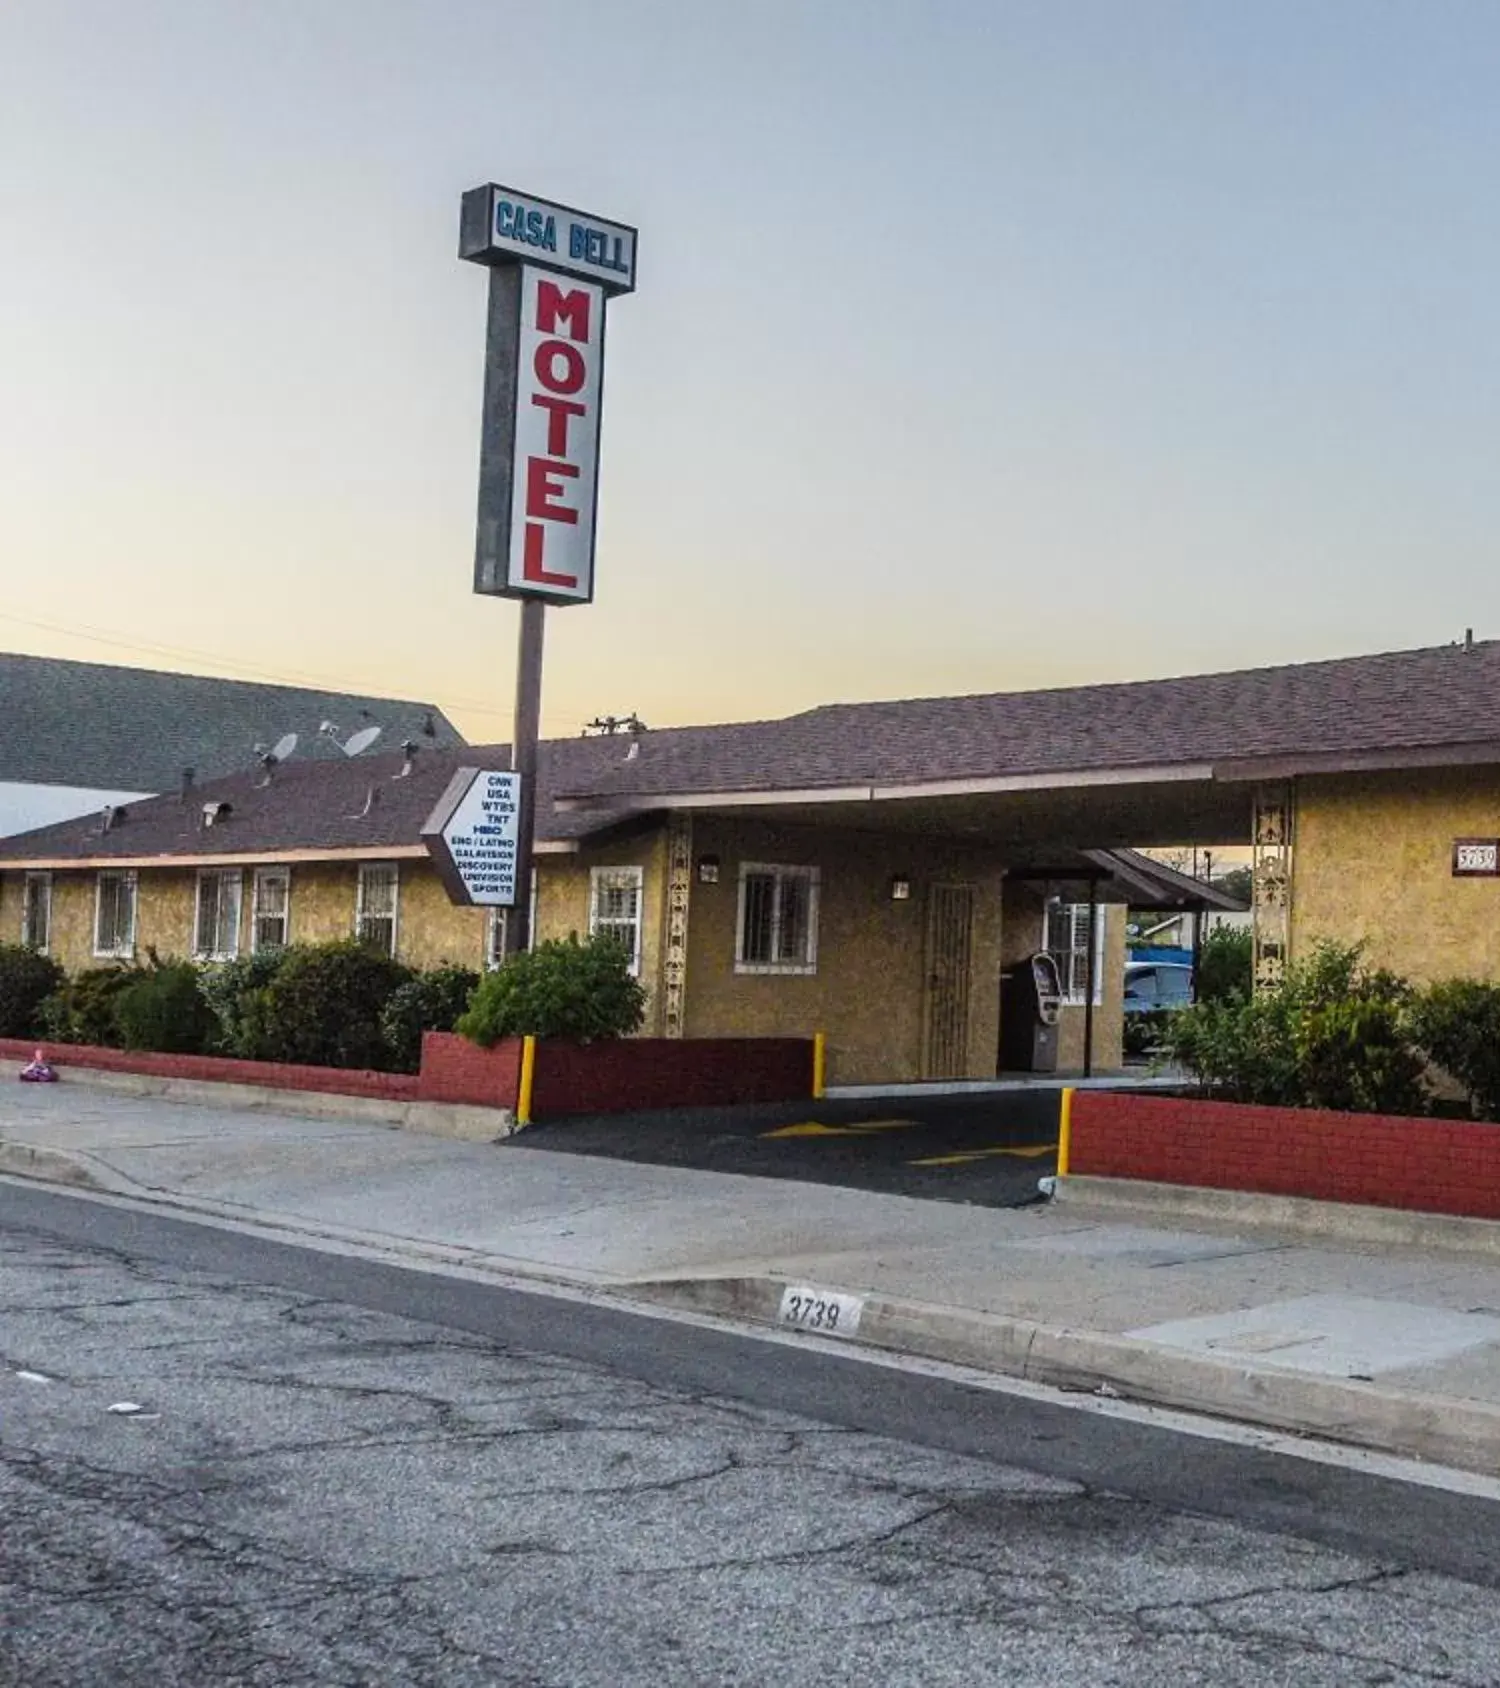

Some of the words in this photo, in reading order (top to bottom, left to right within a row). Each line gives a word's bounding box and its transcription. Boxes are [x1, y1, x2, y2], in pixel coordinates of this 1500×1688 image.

[496, 200, 557, 253] CASA
[569, 222, 628, 274] BELL
[523, 278, 591, 589] MOTEL
[487, 789, 511, 799] USA
[482, 801, 515, 812] WTBS
[486, 814, 510, 824] TNT
[473, 825, 502, 835] HBO
[457, 861, 513, 871] DISCOVERY
[464, 873, 513, 883] UNIVISION
[472, 884, 512, 894] SPORTS
[785, 1296, 840, 1329] 3739
